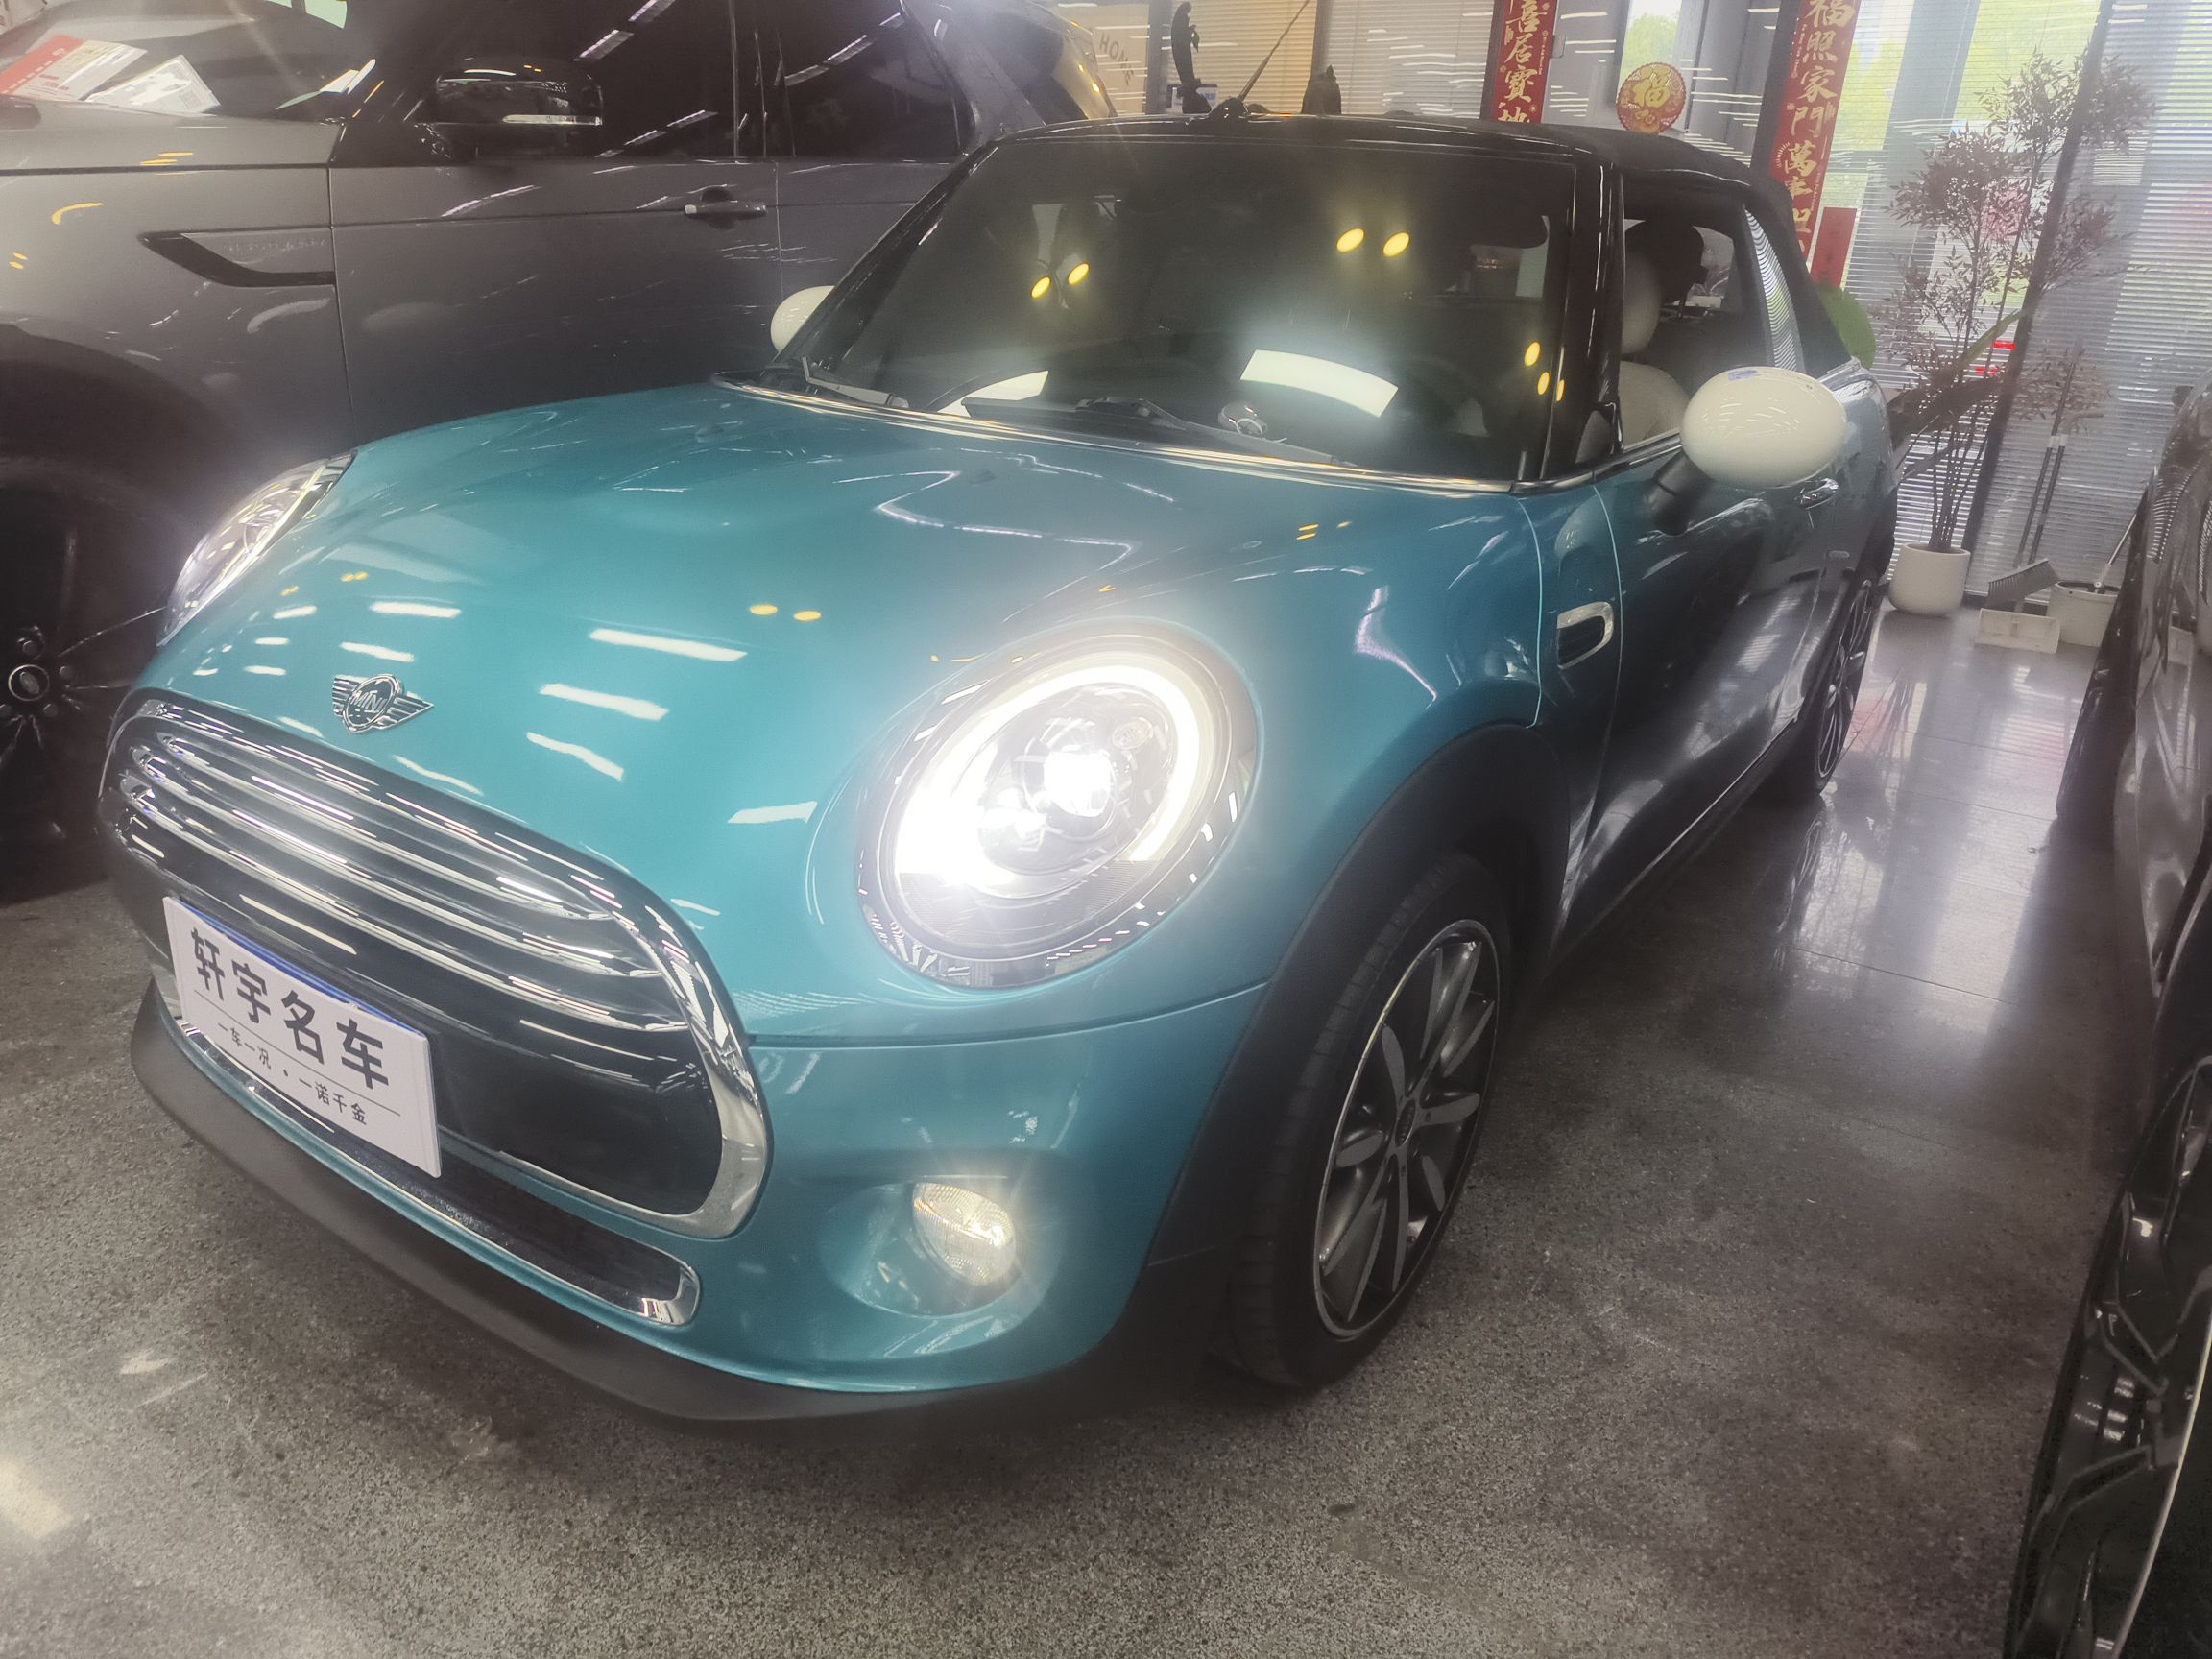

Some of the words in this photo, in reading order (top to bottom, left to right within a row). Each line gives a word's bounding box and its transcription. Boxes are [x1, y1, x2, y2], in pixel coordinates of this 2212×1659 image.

[1633, 72, 1671, 108] 福
[349, 690, 389, 712] MINI
[191, 926, 389, 1090] 轩宇名车
